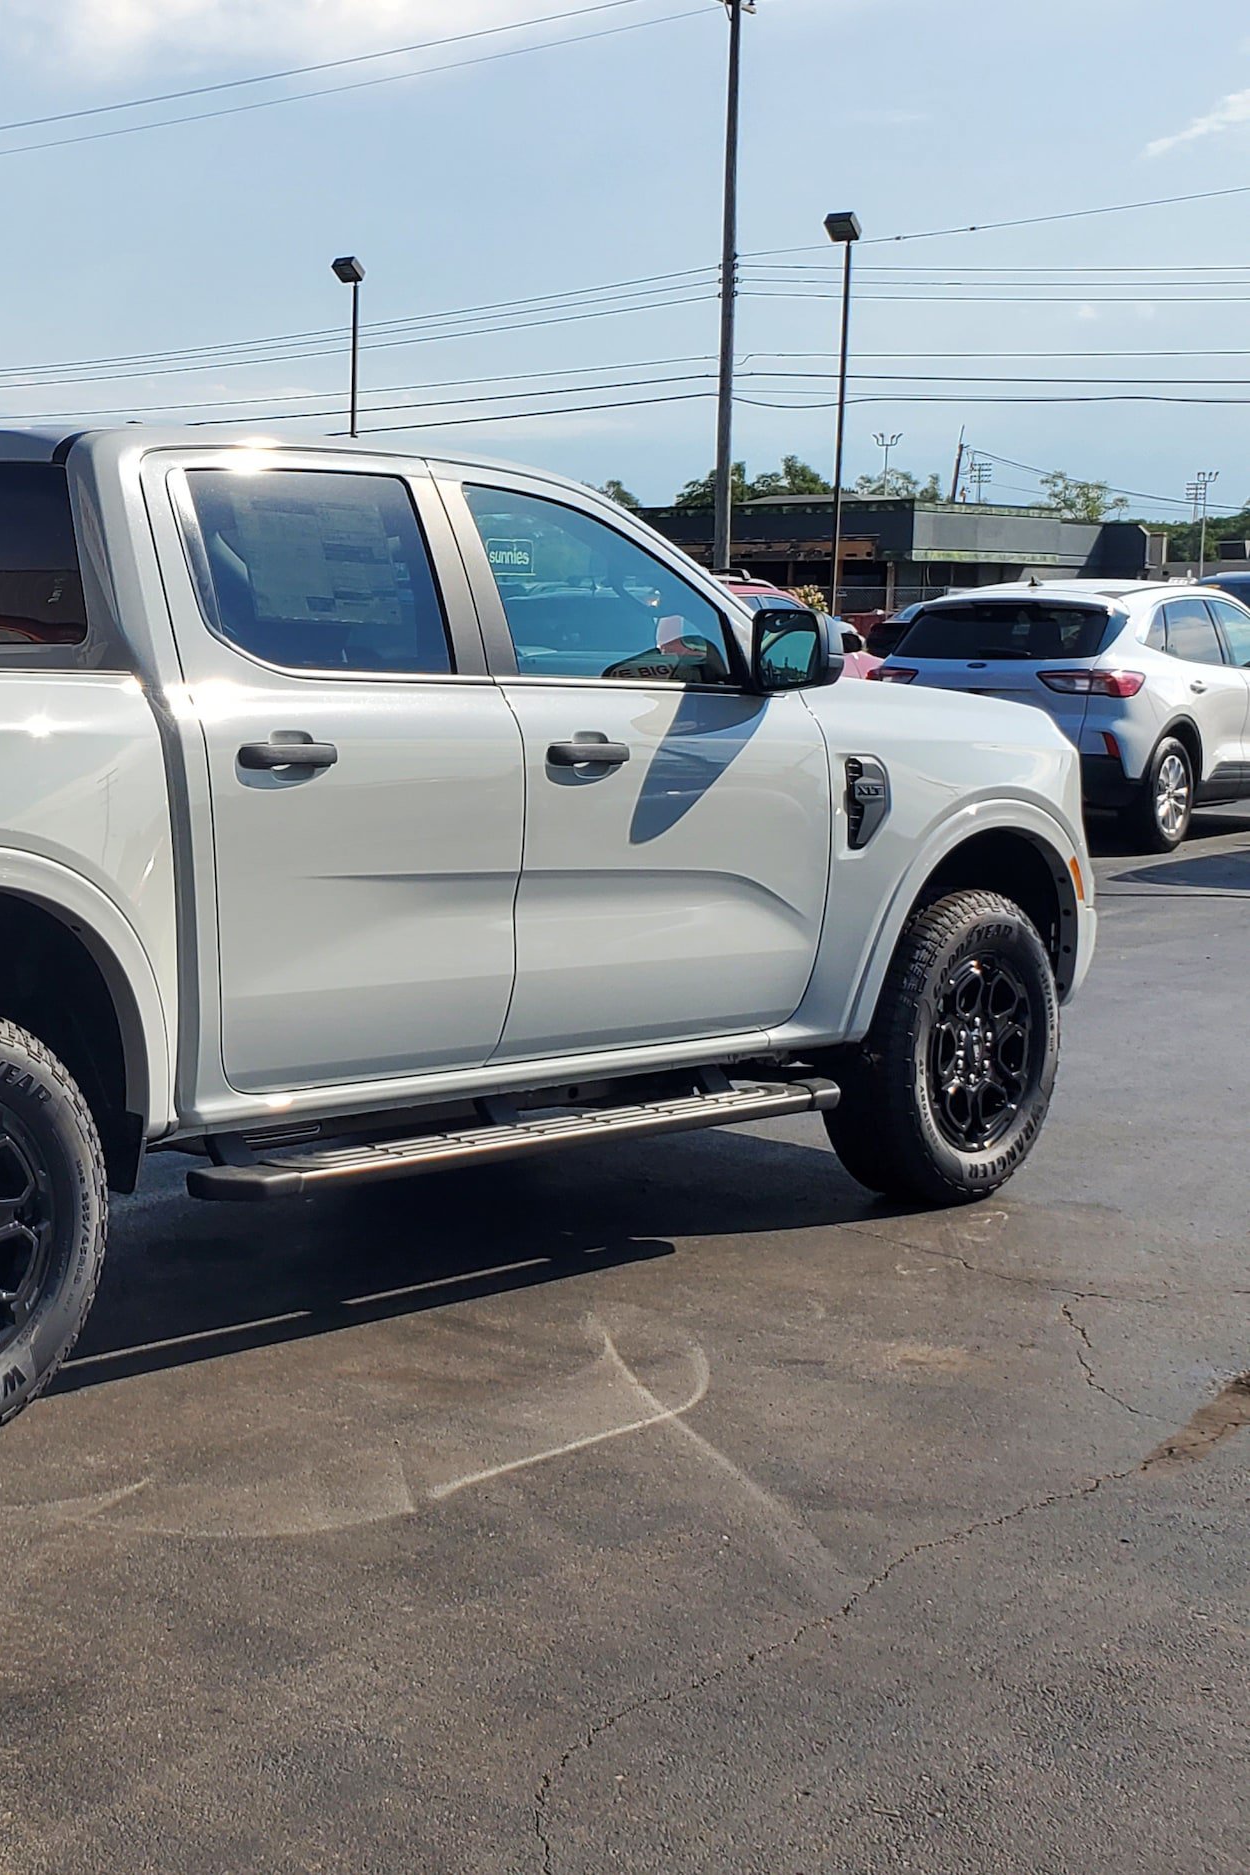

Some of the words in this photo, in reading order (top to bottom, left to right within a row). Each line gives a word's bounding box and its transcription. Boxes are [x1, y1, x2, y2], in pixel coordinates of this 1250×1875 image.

[489, 546, 530, 565] sunnies
[857, 784, 884, 796] XLT
[968, 1102, 1044, 1179] WRANGLER
